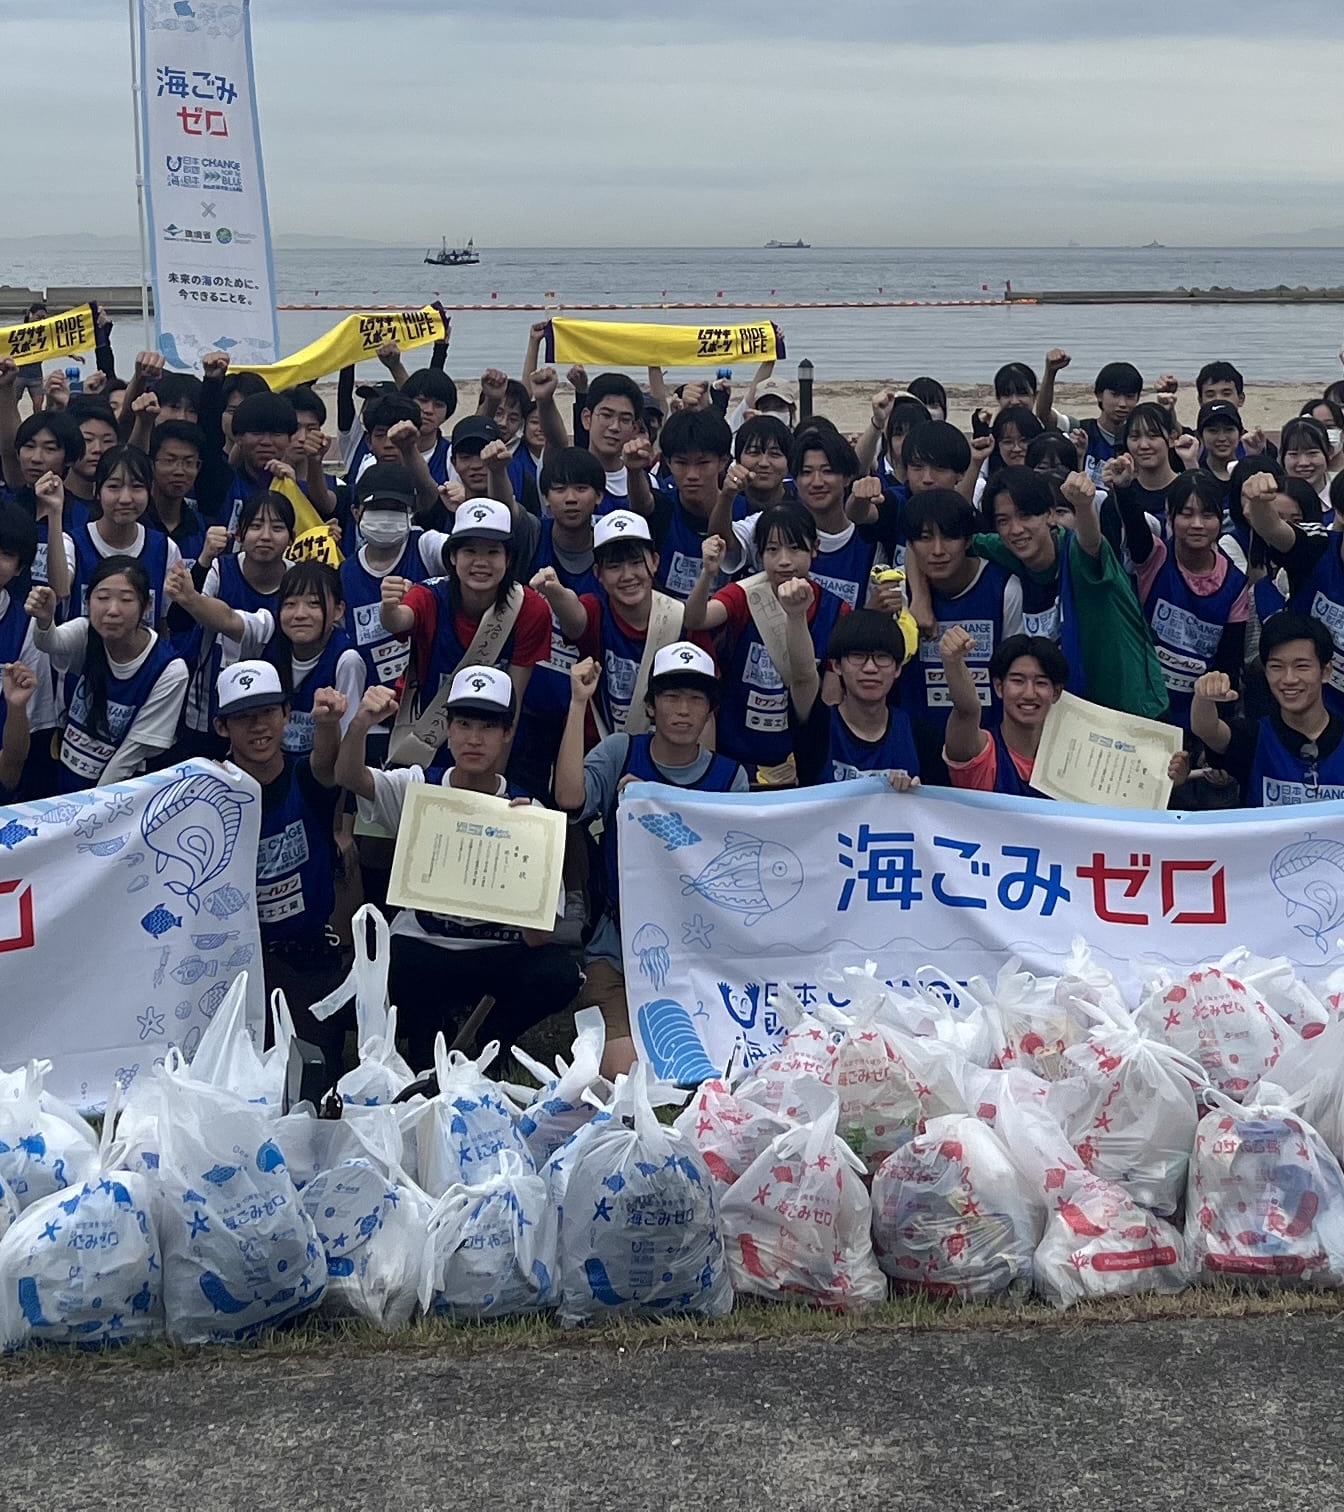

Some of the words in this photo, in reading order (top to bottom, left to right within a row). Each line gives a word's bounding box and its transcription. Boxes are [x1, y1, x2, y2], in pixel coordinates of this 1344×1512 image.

[156, 65, 238, 105] 海ごみ
[176, 106, 229, 137] ゼロ
[201, 158, 241, 170] CHANGE
[56, 314, 84, 334] RIDE
[407, 322, 436, 340] LIFE
[56, 329, 86, 349] LIFE
[740, 339, 768, 355] LIFE
[281, 847, 306, 863] BLUE
[837, 824, 1228, 926] 海ごみゼロ
